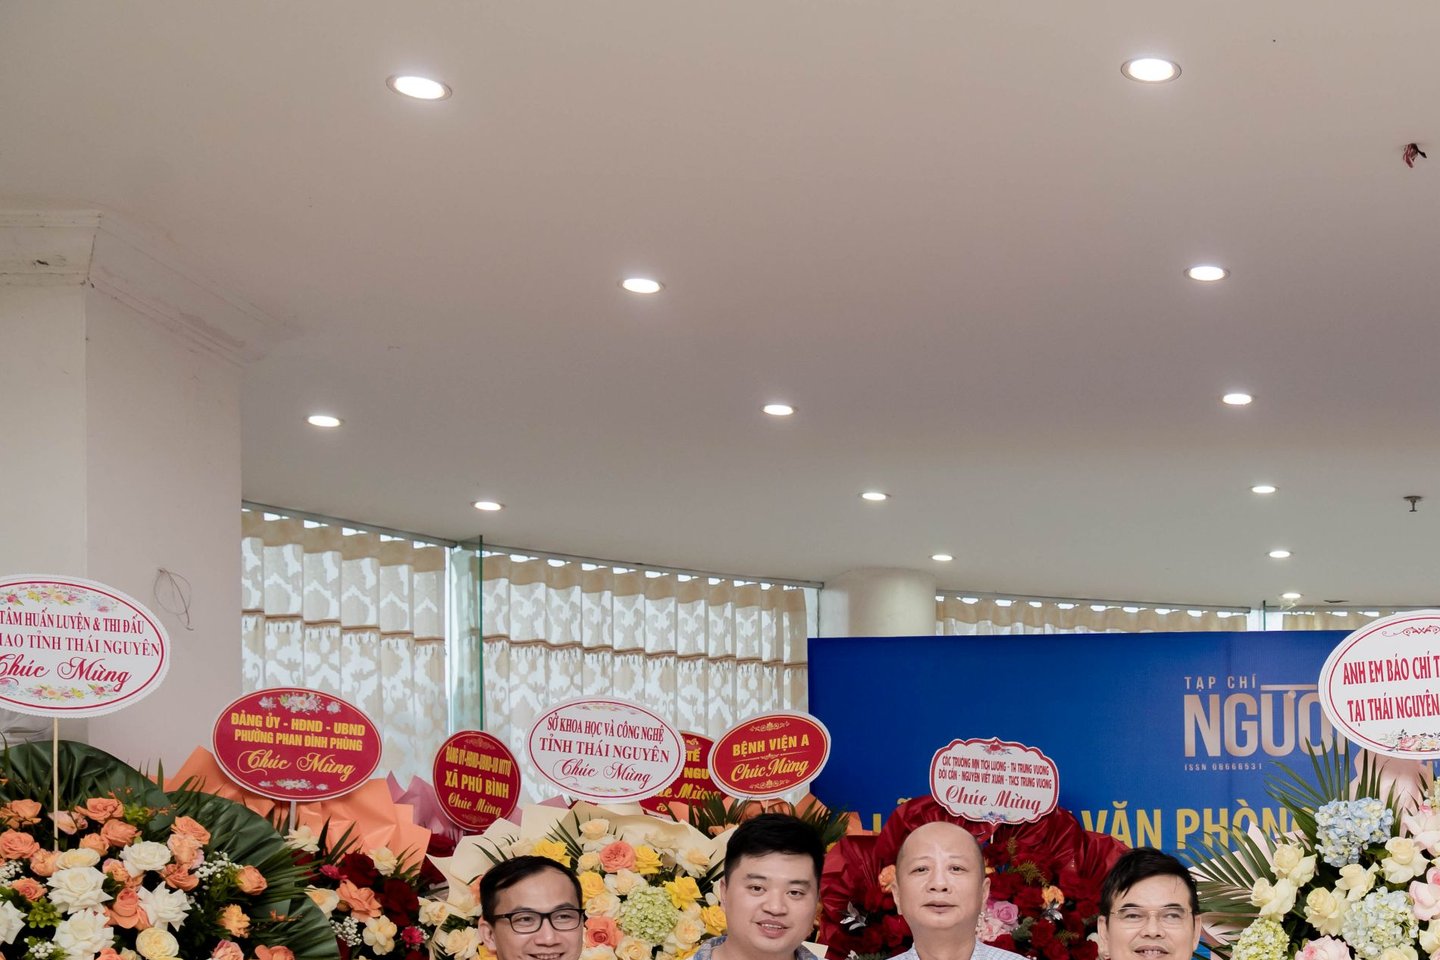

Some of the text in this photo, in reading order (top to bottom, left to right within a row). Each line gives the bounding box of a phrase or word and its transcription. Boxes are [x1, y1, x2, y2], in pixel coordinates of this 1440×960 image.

[25, 607, 54, 628] HUẤN
[57, 612, 91, 633] LUYỆN
[93, 617, 100, 631] &
[103, 618, 121, 633] THI
[123, 614, 145, 634] ĐẤU
[27, 630, 61, 650] TỈNH
[65, 635, 99, 653] THÁI
[103, 638, 160, 657] NGUYÊN
[57, 656, 132, 692] Mừng
[1184, 674, 1257, 692] TẠP CHÍ
[1343, 662, 1366, 685] ANH
[1368, 660, 1383, 683] EM
[1387, 653, 1409, 682] BÁO
[1412, 651, 1431, 679] CHÍ
[231, 709, 263, 727] ĐẢNG
[265, 712, 280, 729] ỦY
[291, 718, 323, 733] HĐND
[333, 722, 366, 737] UBND
[1347, 699, 1366, 727] TẠI
[1367, 692, 1394, 721] THÁI
[1396, 689, 1440, 719] NGUYÊN
[234, 728, 363, 751] PHƯỜNG PHAN ĐÌNH PHÙNG
[547, 712, 665, 744] SỞ KHOA HỌC VÀ CÔNG NGHỆ
[540, 734, 670, 764] TỈNH THÁI NGUYÊN
[732, 734, 810, 757] BỆNH VIỆN A
[237, 749, 356, 782] Chúc Mừng
[553, 758, 652, 790] Chúc Mừng
[730, 757, 810, 783] Chúc Mừng
[1184, 763, 1207, 771] ISSN
[444, 768, 509, 799] XÃ PHÚ BÌNH
[945, 785, 1042, 815] Chúc Mừng
[1081, 800, 1163, 850] VĂN
